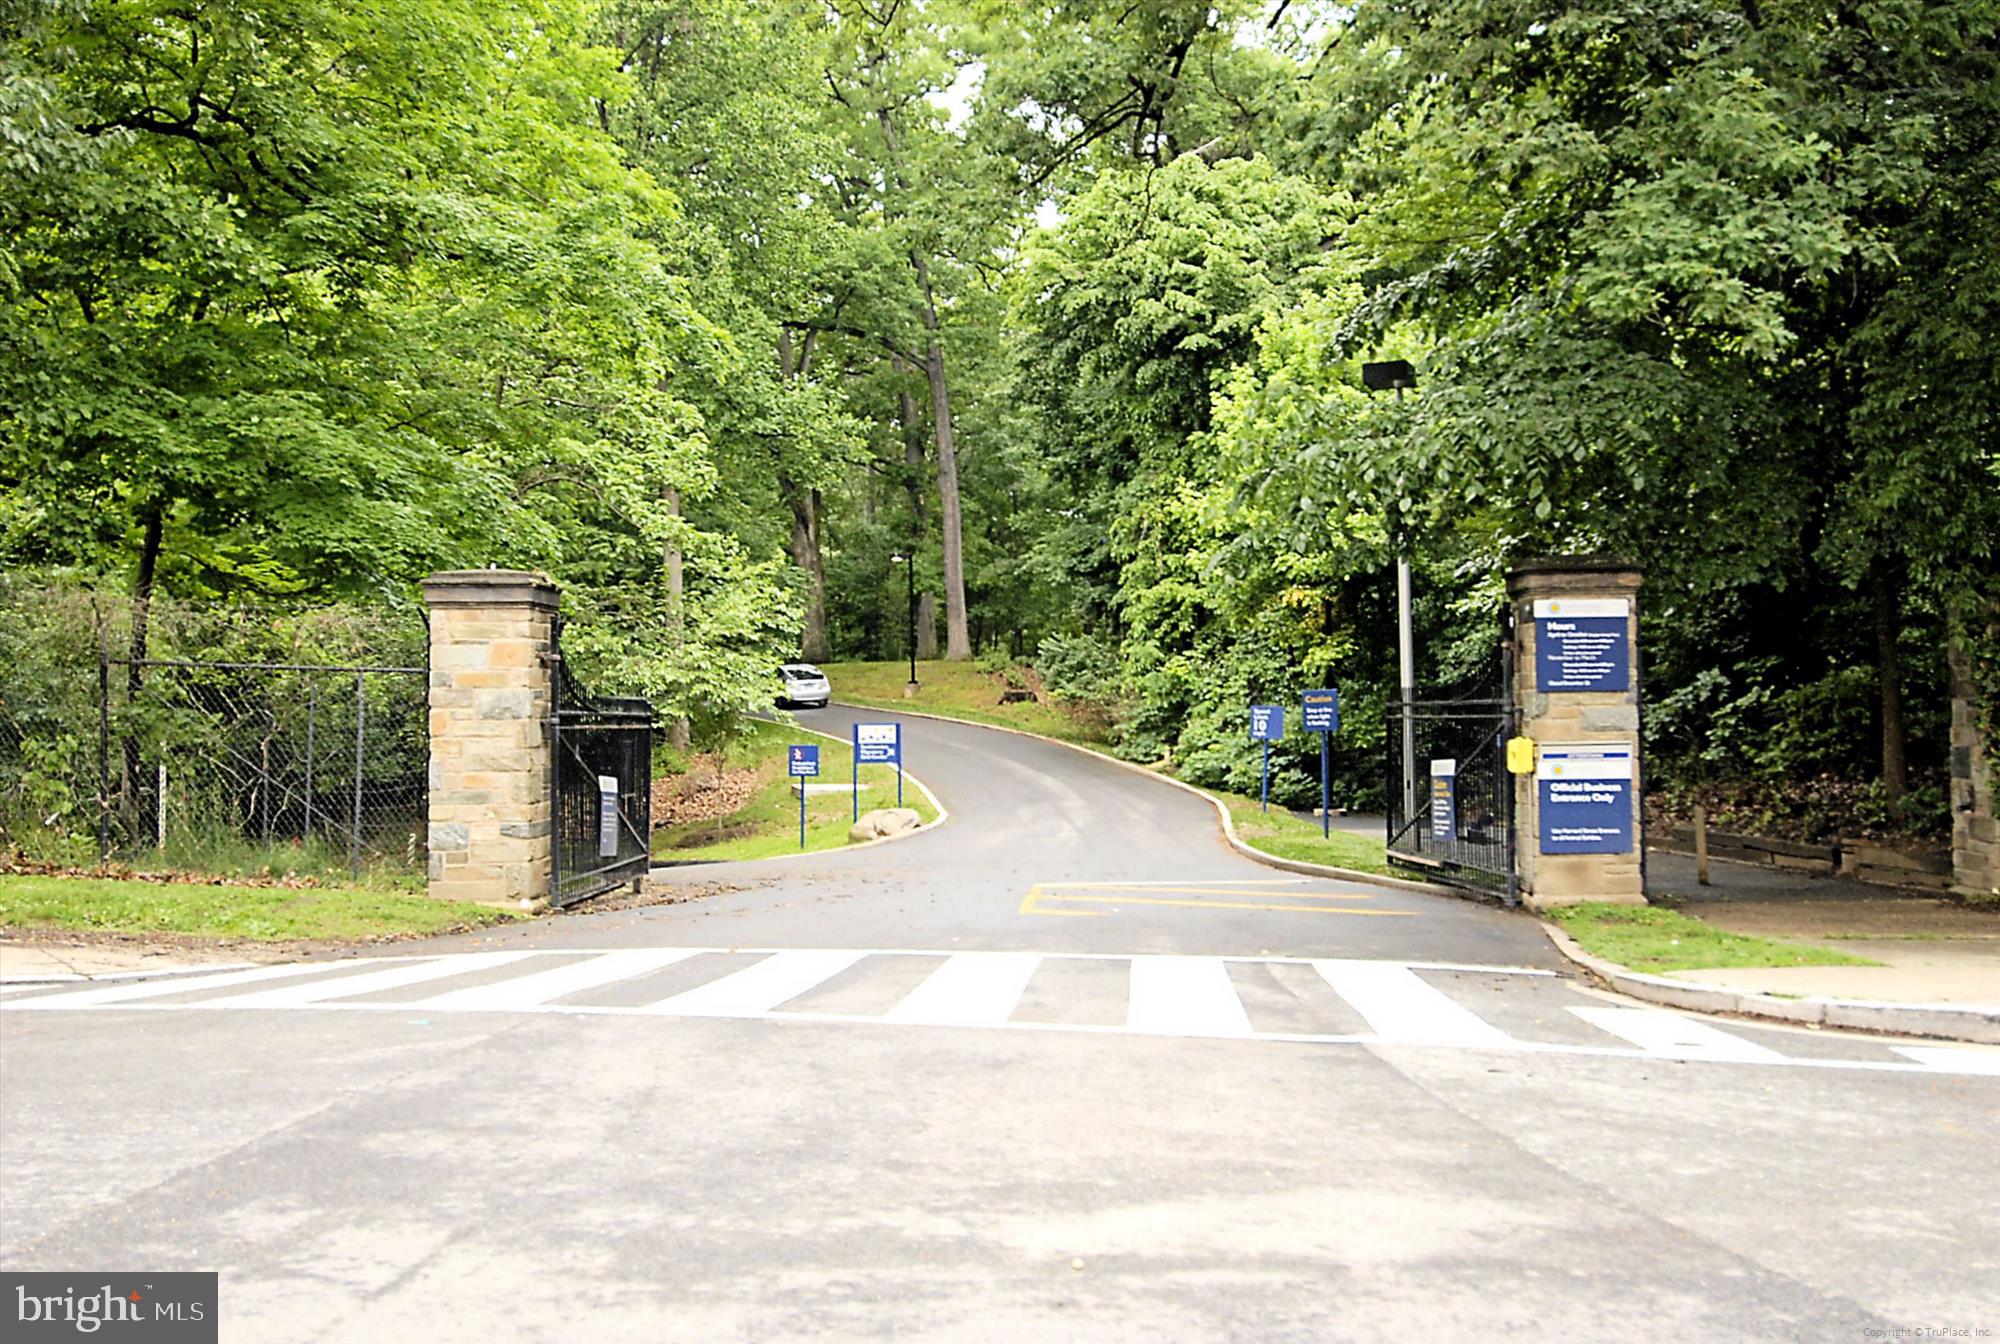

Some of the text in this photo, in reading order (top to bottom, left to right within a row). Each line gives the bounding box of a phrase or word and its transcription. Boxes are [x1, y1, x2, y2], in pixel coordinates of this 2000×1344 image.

[1547, 622, 1576, 631] Hours
[1305, 695, 1333, 703] Caution
[1253, 719, 1267, 731] 10
[1550, 782, 1622, 792] Official Business
[1550, 793, 1615, 805] Entrance Only
